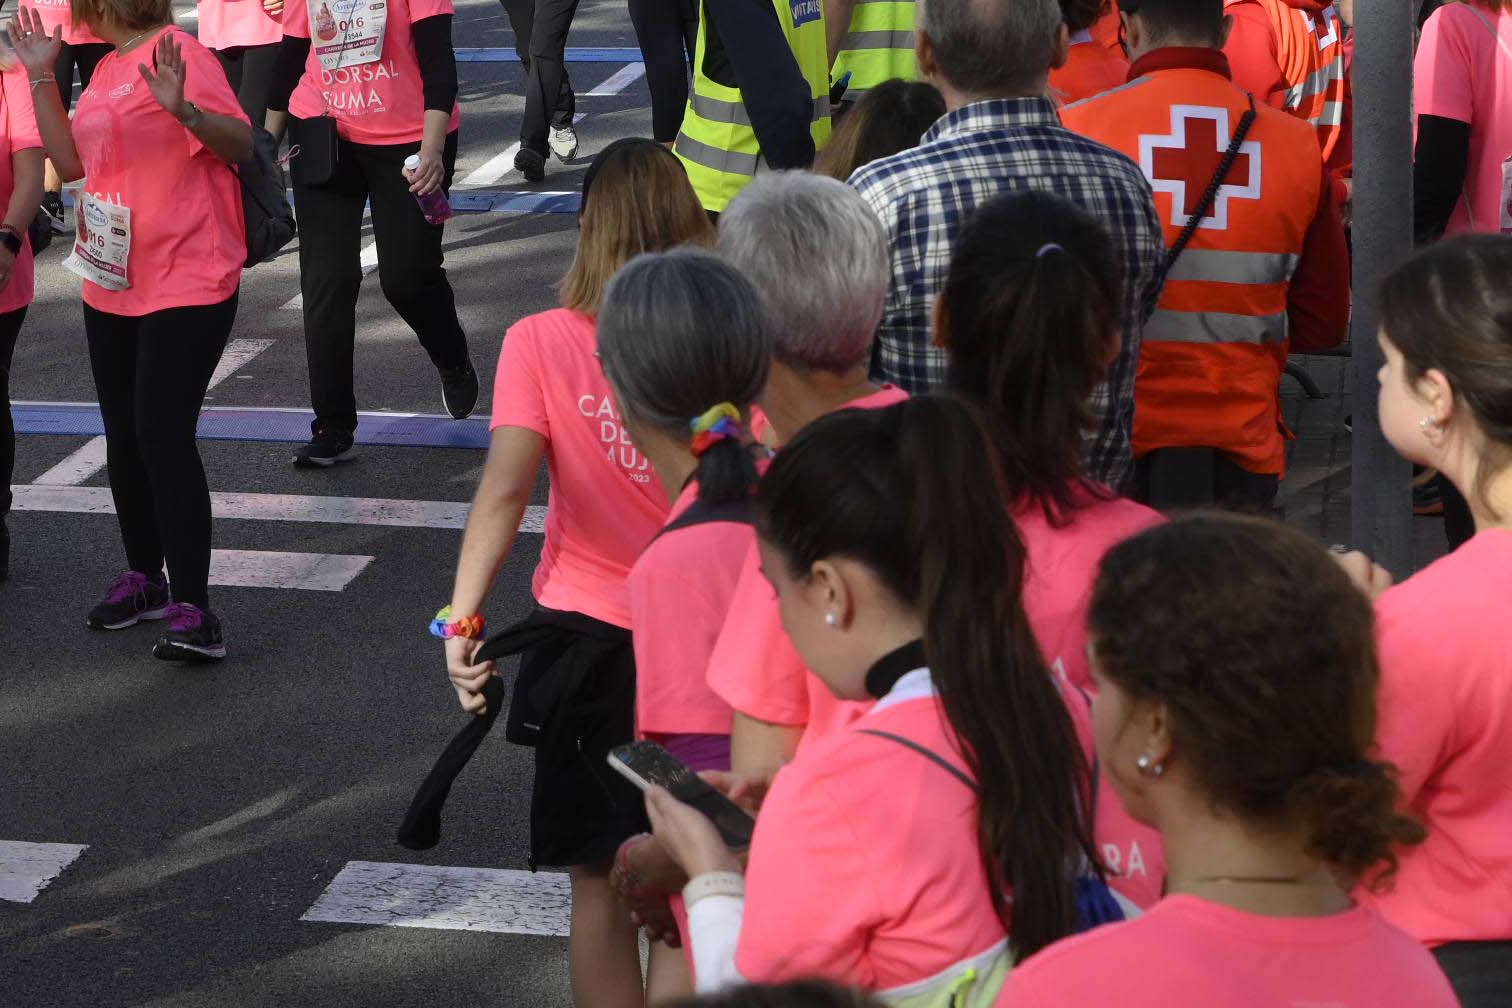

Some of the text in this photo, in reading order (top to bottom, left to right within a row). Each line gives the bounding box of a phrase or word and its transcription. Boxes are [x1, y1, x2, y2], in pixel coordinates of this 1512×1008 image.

[339, 17, 365, 32] 016
[321, 60, 399, 86] DORSAL
[322, 88, 383, 110] SUMA
